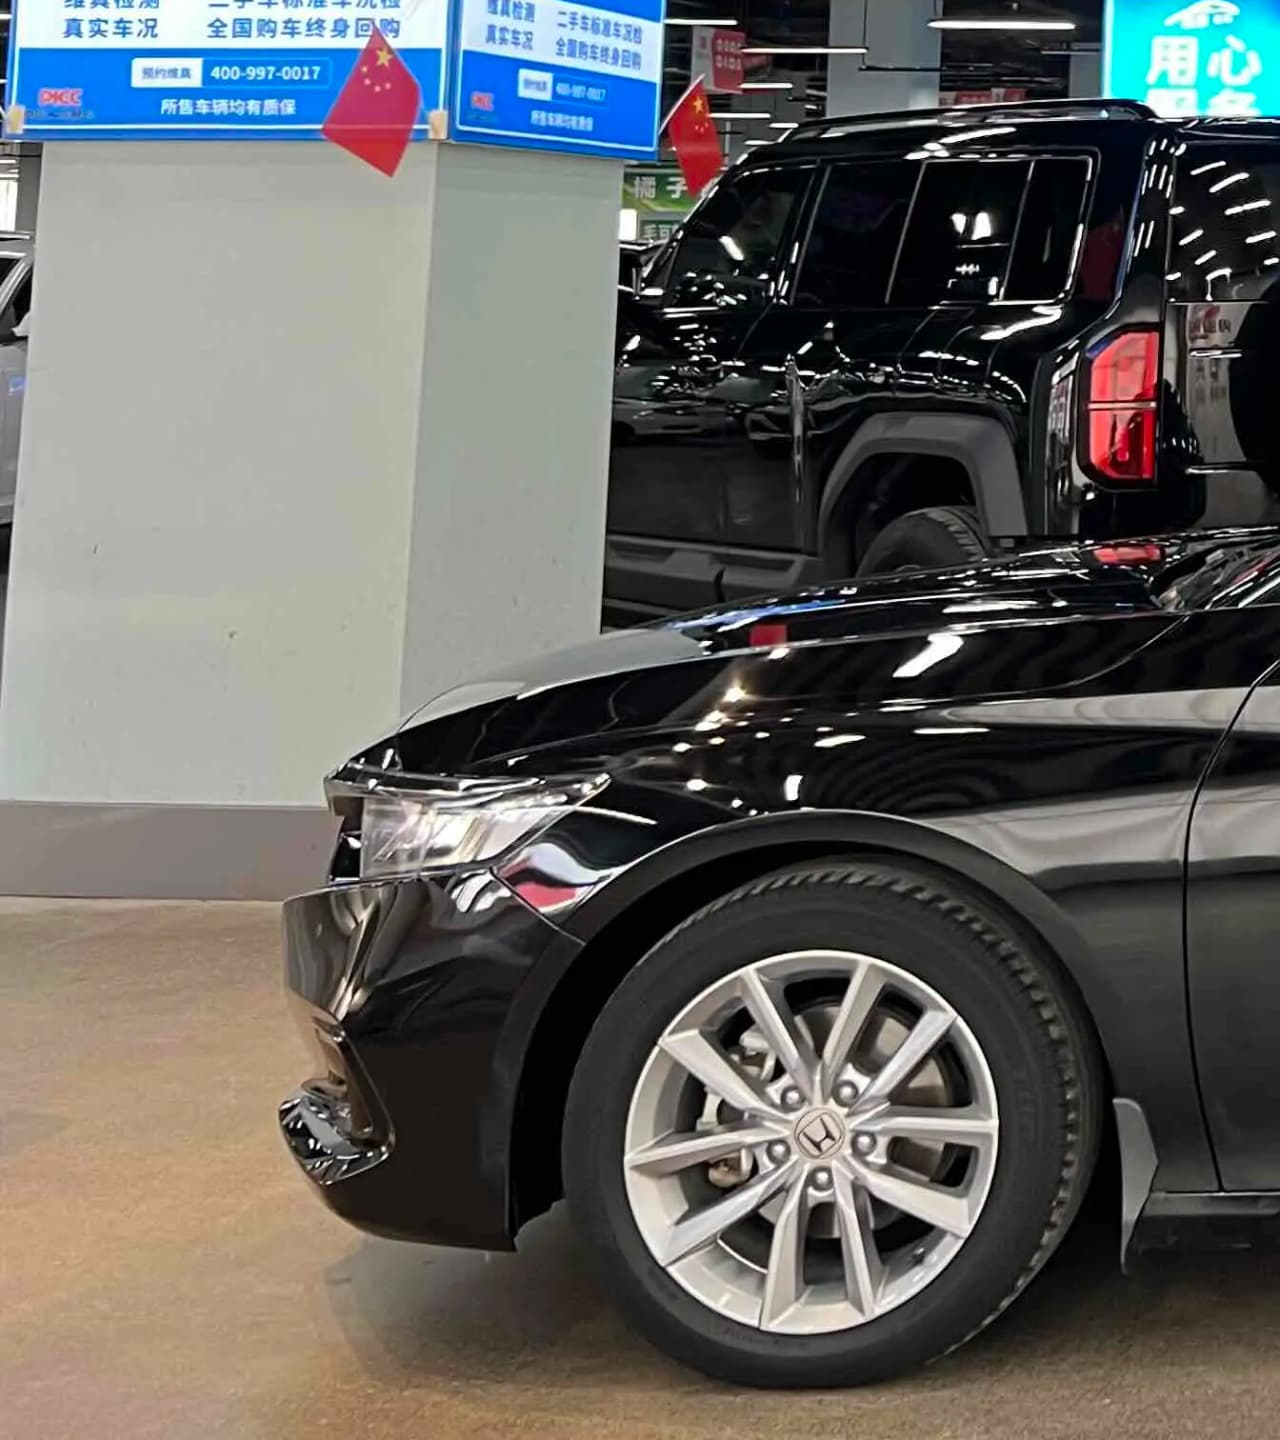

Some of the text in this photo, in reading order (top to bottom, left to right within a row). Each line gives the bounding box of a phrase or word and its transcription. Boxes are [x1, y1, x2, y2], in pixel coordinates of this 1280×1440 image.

[63, 17, 402, 40] 真实车况 全国购车终身回购
[1147, 34, 1262, 86] 用心
[210, 65, 321, 81] 400-997-0017
[160, 98, 296, 115] 所售车辆均有质保
